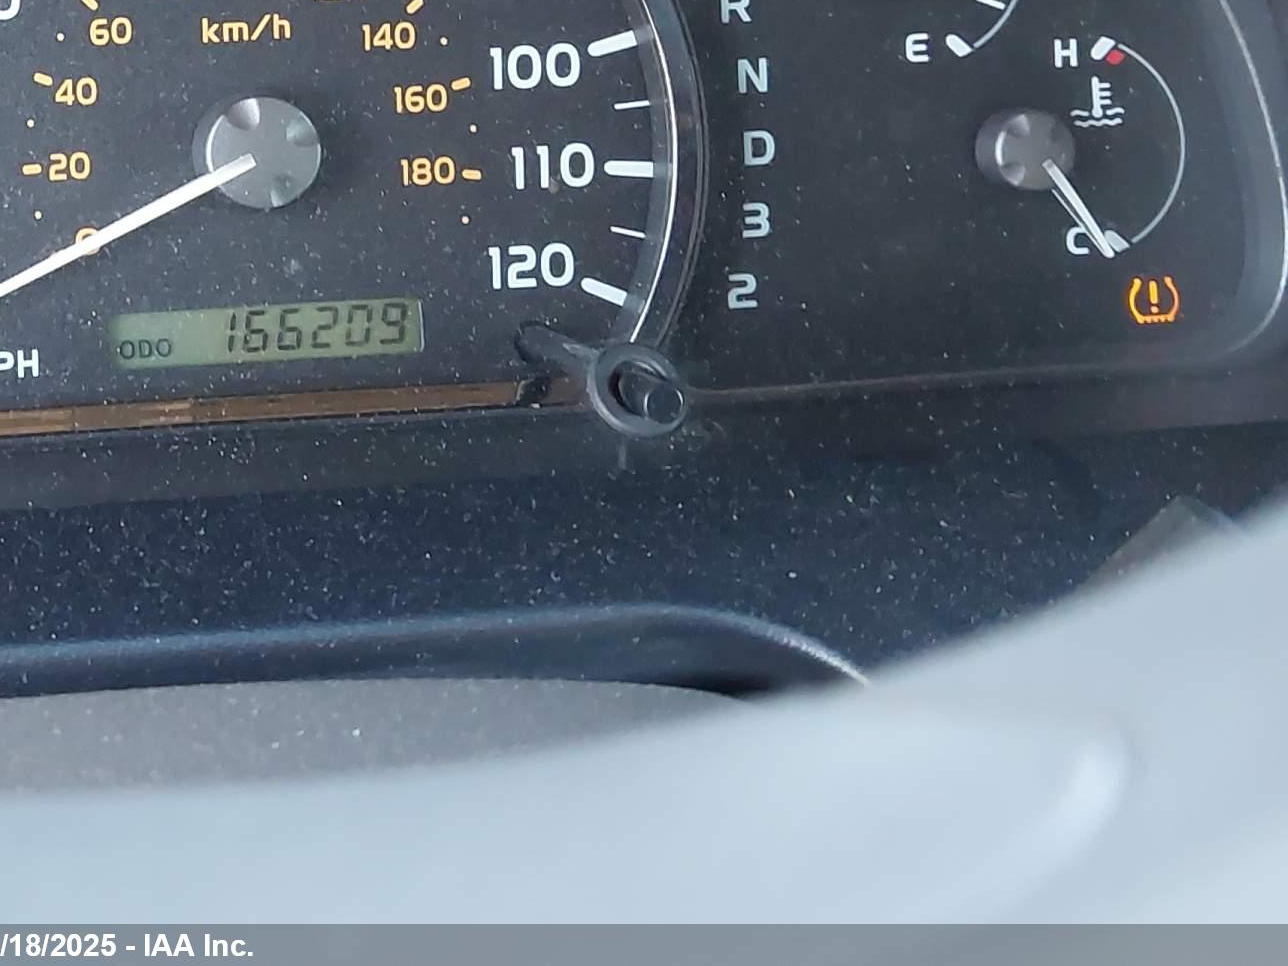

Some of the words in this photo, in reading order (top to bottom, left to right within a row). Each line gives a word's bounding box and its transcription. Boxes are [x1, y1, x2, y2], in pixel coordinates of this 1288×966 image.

[88, 16, 133, 47] 60
[200, 12, 291, 45] km/h
[361, 21, 417, 52] 140
[905, 33, 930, 63] E
[1053, 38, 1079, 68] H
[489, 41, 581, 91] 100
[737, 57, 768, 94] N
[54, 75, 98, 107] 40
[393, 83, 449, 114] 160
[743, 130, 775, 166] D
[48, 152, 91, 182] 20
[400, 156, 456, 187] 180
[511, 142, 595, 190] 110
[741, 202, 770, 238] 3
[1066, 227, 1092, 256] C
[487, 241, 575, 290] 120
[727, 273, 758, 310] 2
[119, 338, 172, 360] ODO
[226, 302, 408, 356] 166209
